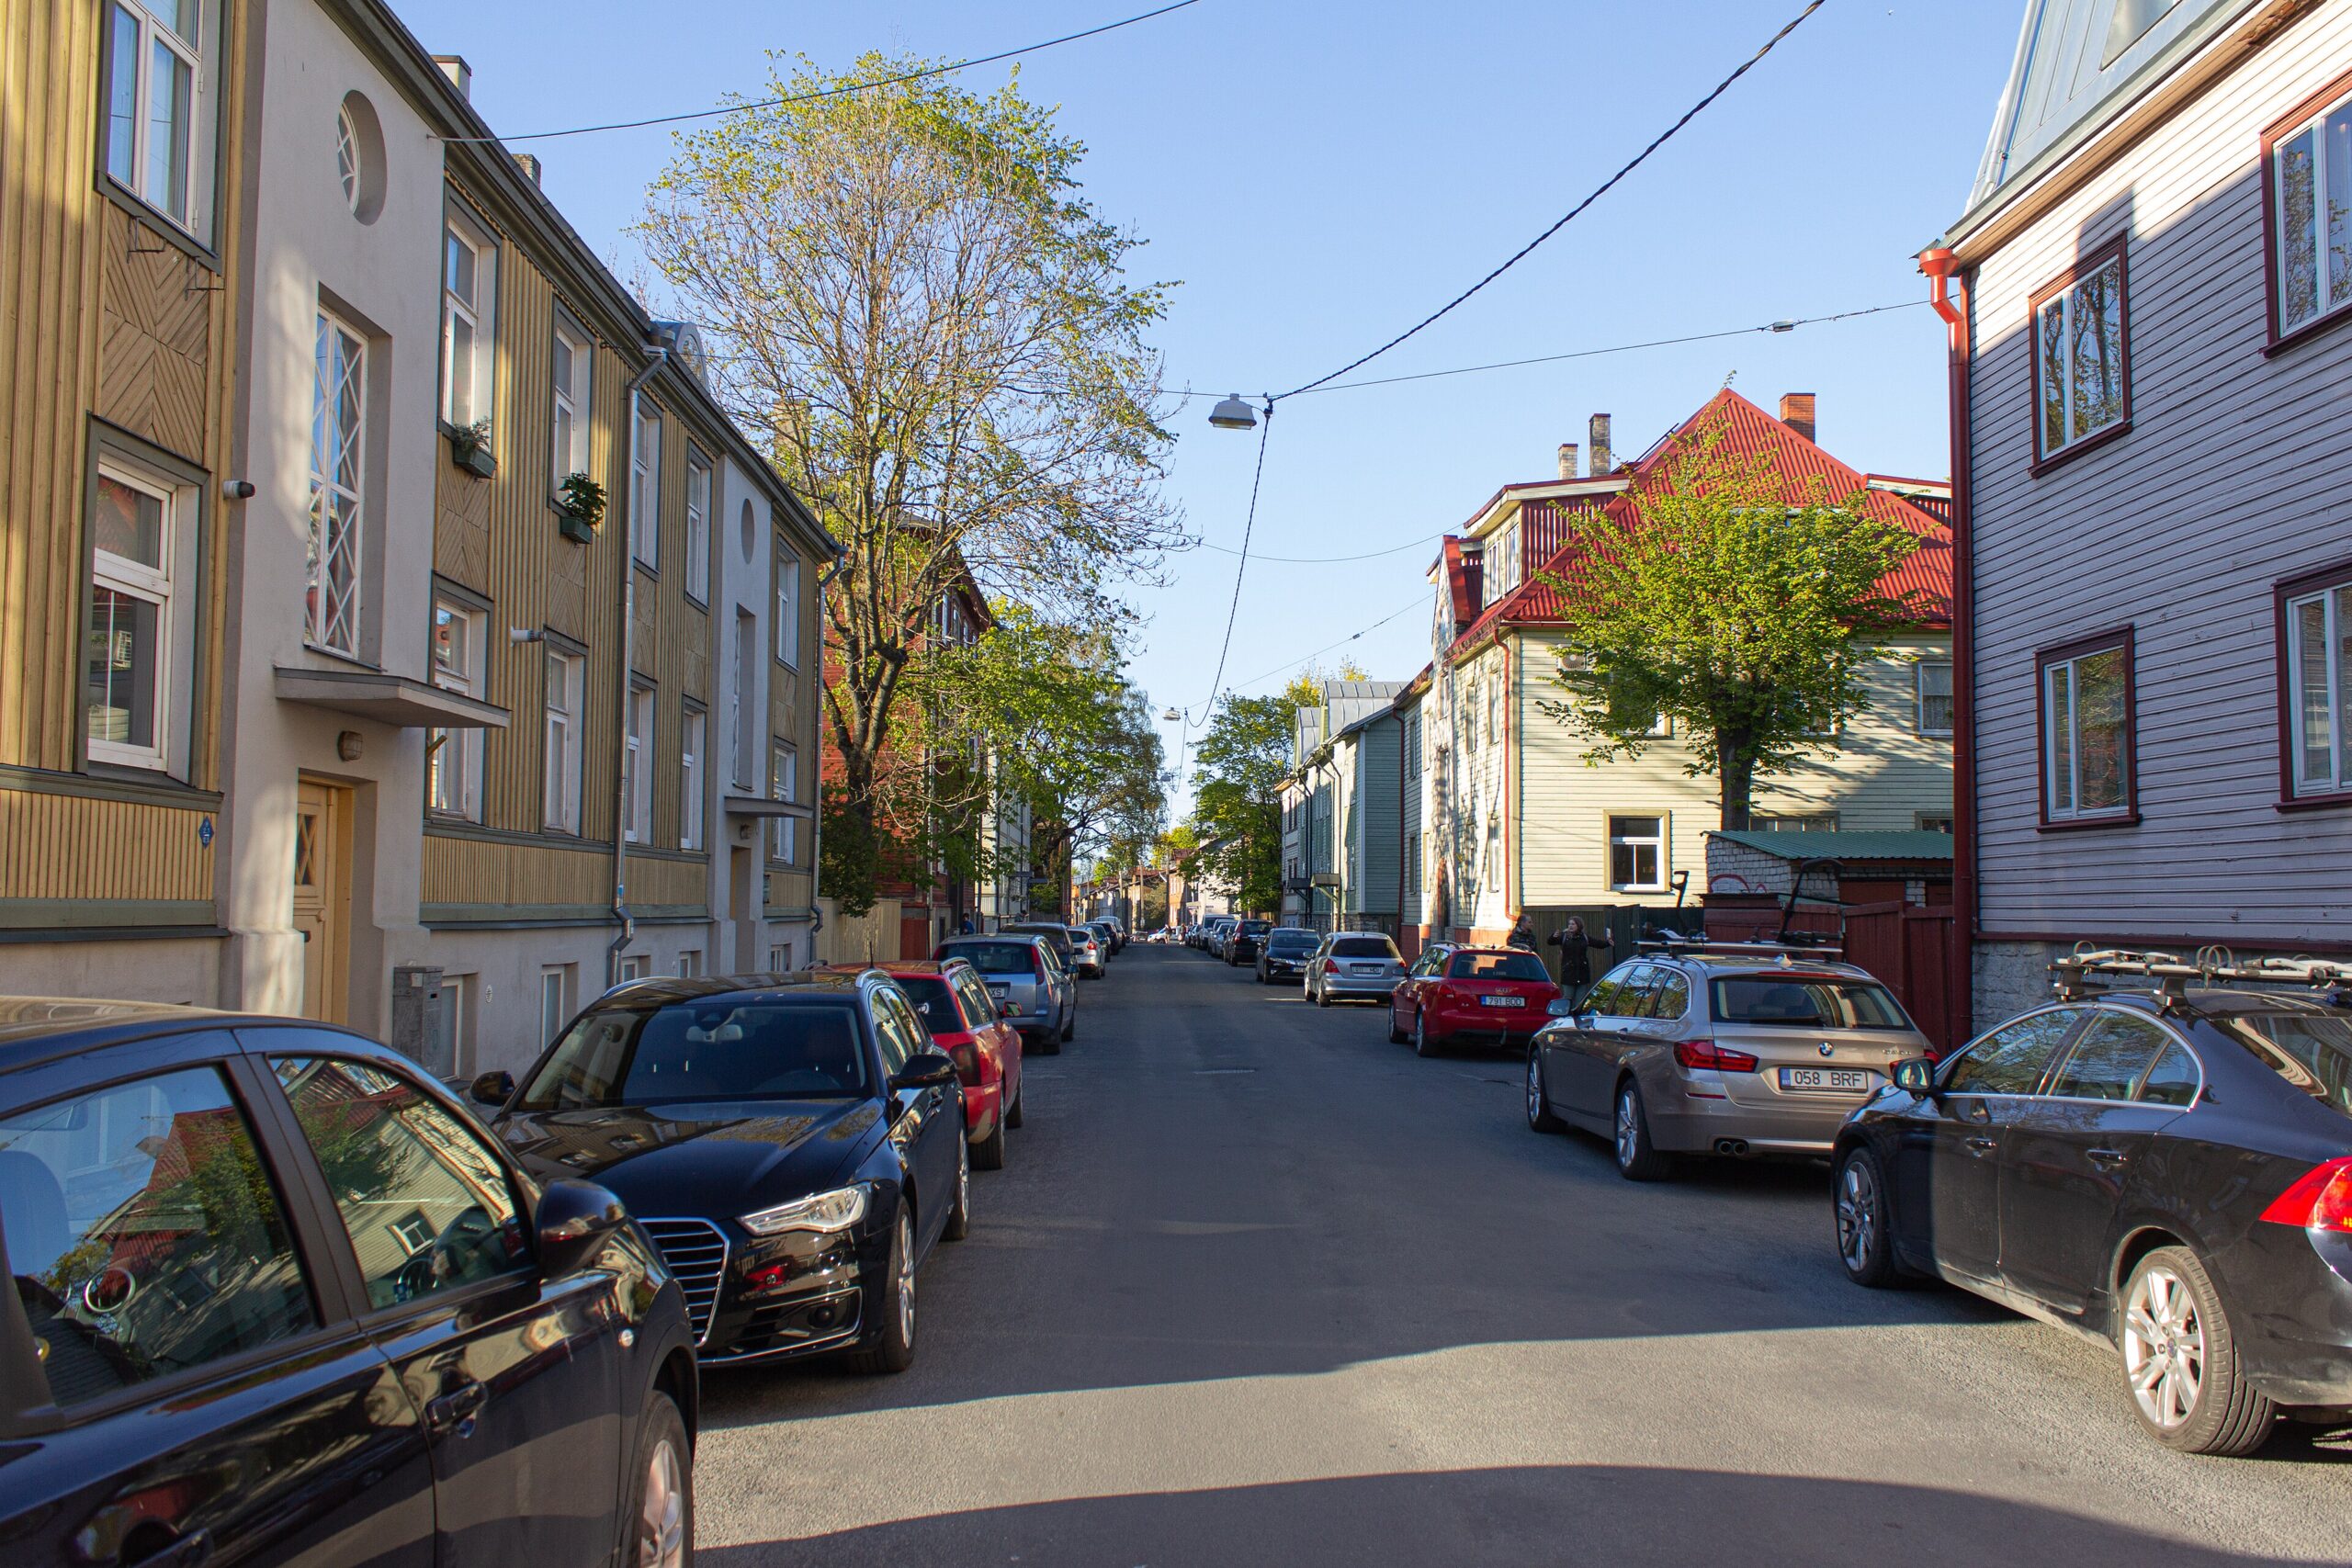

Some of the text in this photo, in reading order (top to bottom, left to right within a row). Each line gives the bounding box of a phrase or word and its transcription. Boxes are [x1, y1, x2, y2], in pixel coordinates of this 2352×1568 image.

[1489, 997, 1501, 1005] 791
[1794, 1071, 1862, 1087] 058 BRF
